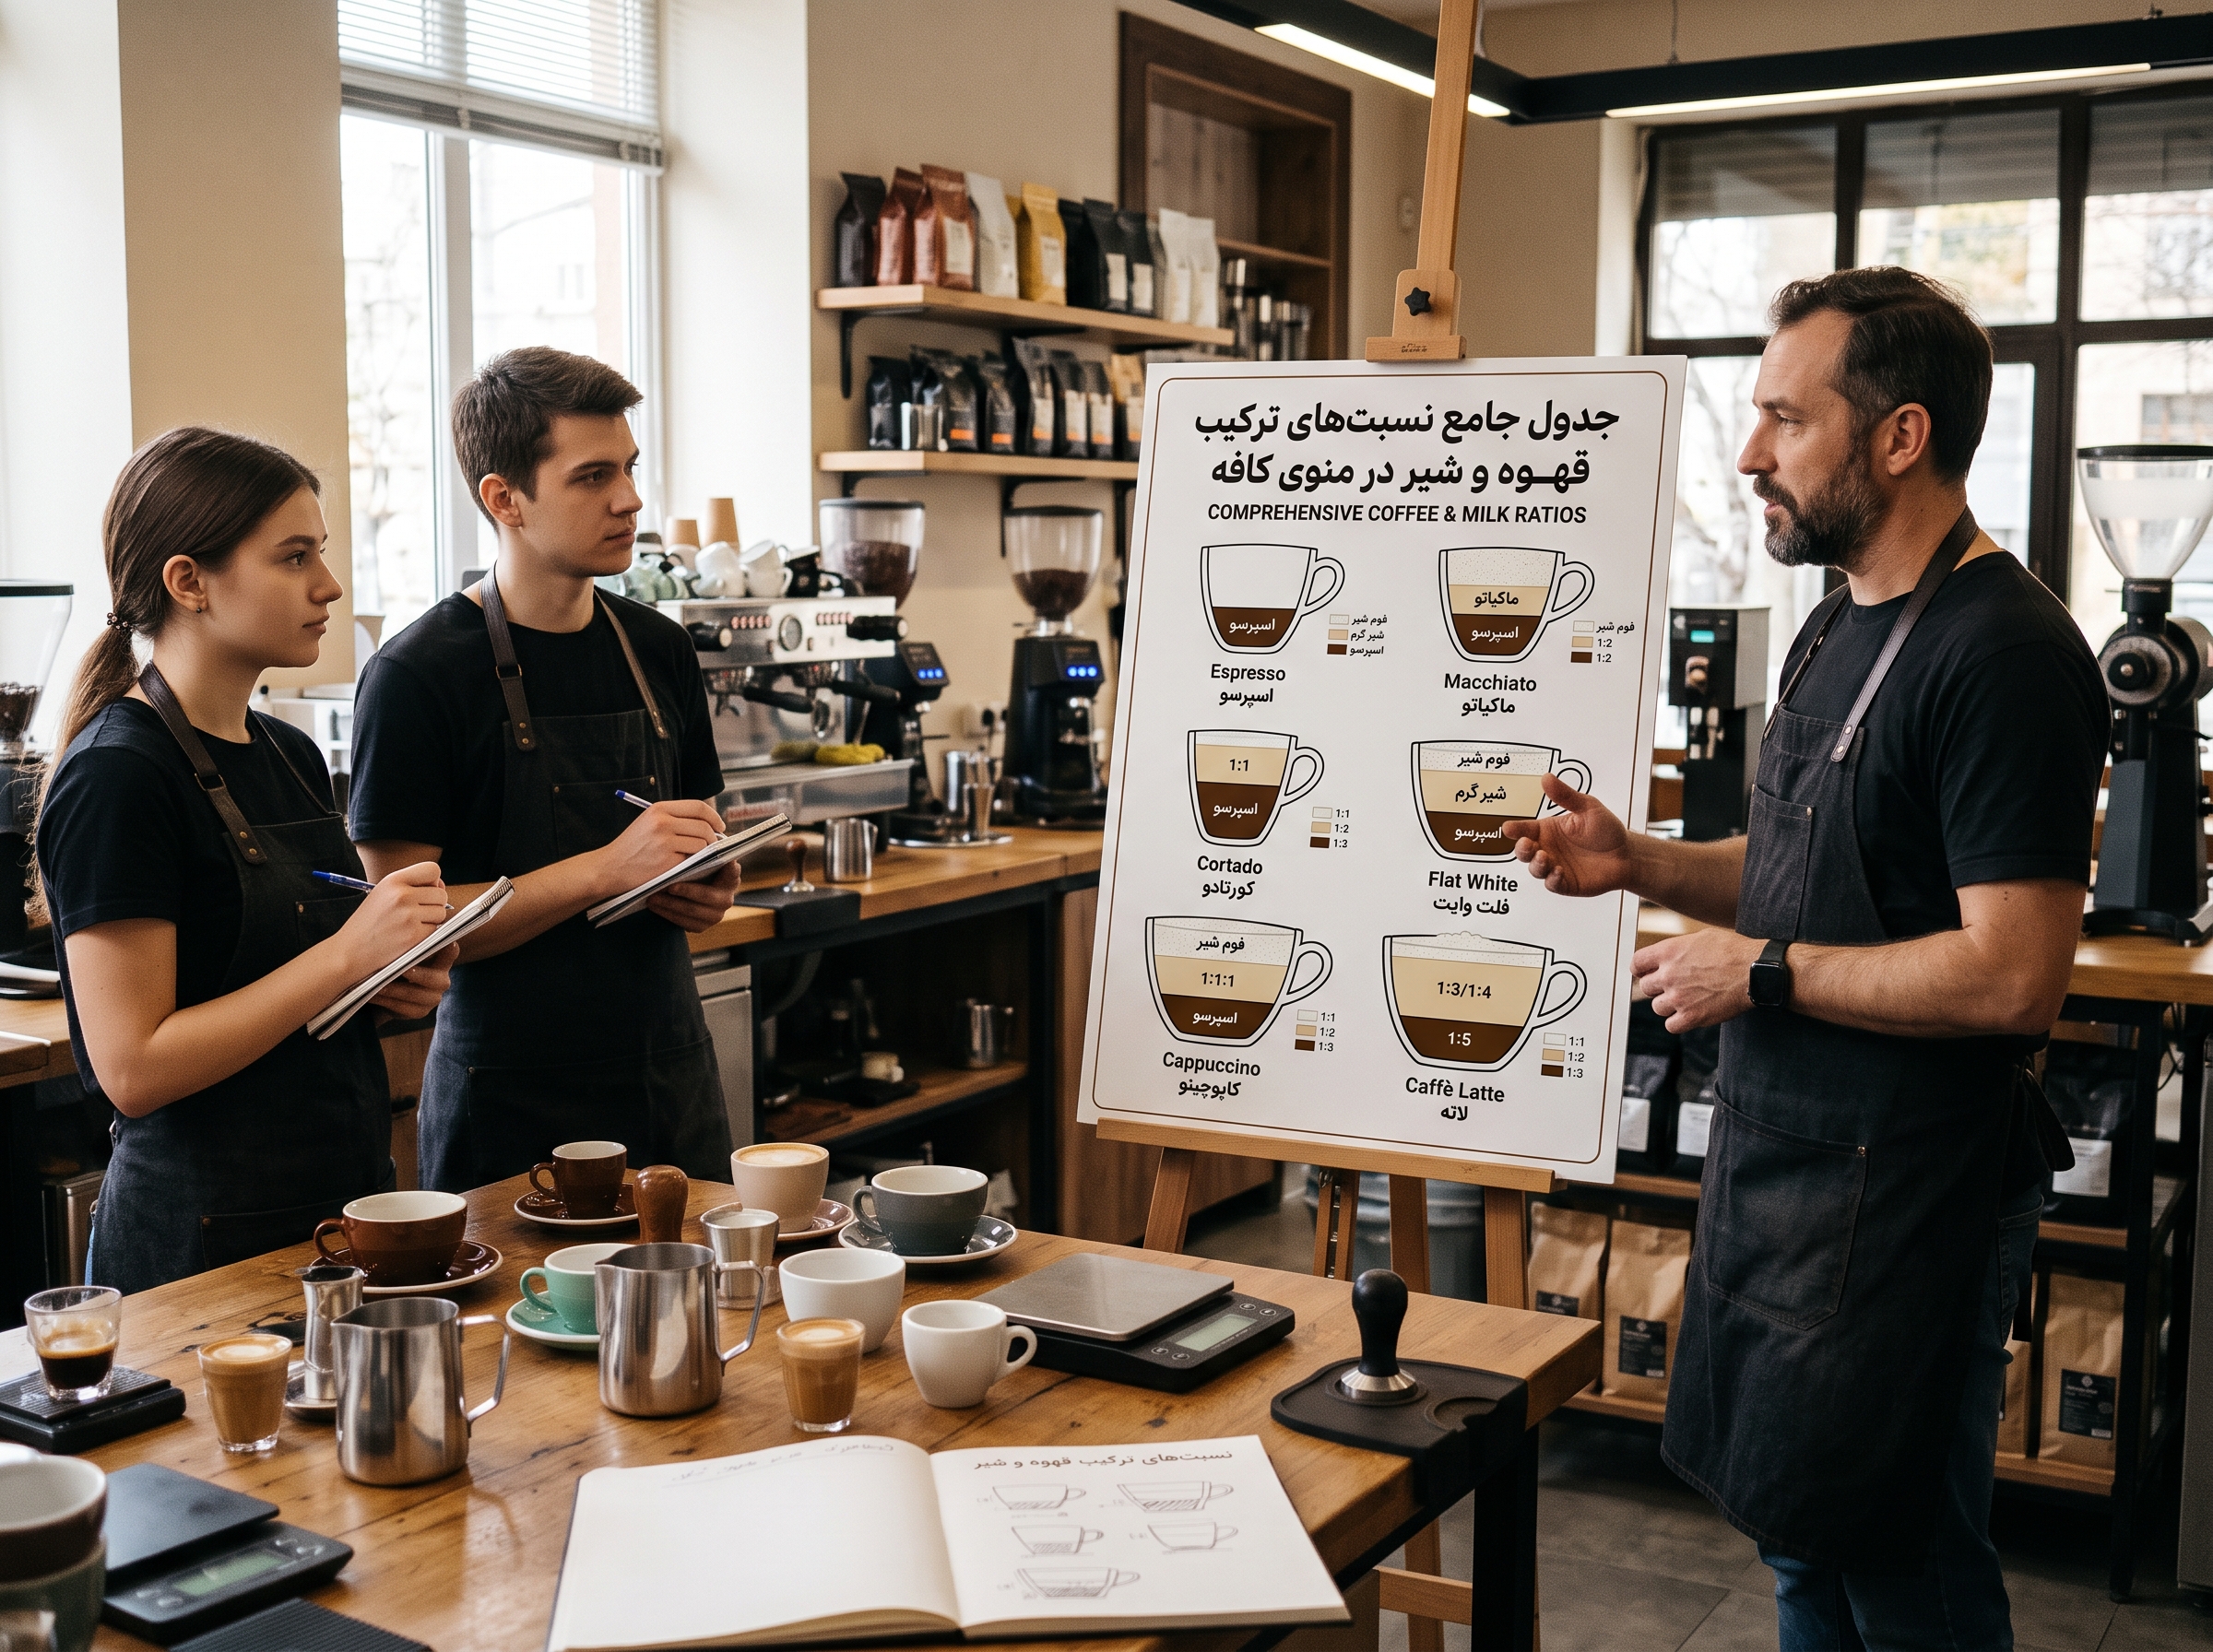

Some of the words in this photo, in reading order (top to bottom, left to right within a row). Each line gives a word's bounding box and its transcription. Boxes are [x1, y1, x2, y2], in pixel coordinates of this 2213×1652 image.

[1196, 403, 1280, 442] ترکیب
[1442, 400, 1520, 443] جامع
[1528, 400, 1619, 441] جدول
[1213, 451, 1274, 483] کافه
[1401, 455, 1462, 492] شیر
[1279, 460, 1354, 492] منوی
[1360, 462, 1393, 493] در
[1471, 465, 1489, 493] و
[1209, 504, 1363, 521] COMPREHENSIVE
[1368, 505, 1439, 521] COFFEE
[1444, 506, 1456, 522] &
[1462, 506, 1509, 522] MILK
[1515, 506, 1586, 523] RATIOS
[1474, 592, 1519, 608] ماکیاتو
[1229, 619, 1274, 634] اسپرسو
[1472, 626, 1518, 643] اسپرسو
[1597, 639, 1612, 647] 1:2
[1596, 654, 1611, 662] 1:2
[1211, 664, 1285, 683] Espresso
[1444, 674, 1536, 691] Macchiato
[1218, 689, 1273, 708] اسپرسو
[1461, 698, 1515, 716] ماکیاتو
[1229, 759, 1248, 771] 1:1
[1456, 751, 1483, 767] شیر
[1485, 753, 1509, 769] فوم
[1455, 783, 1479, 802] گرم
[1479, 785, 1507, 803] شیر
[1213, 803, 1257, 819] اسپرسو
[1335, 809, 1349, 818] 1:1
[1334, 824, 1348, 832] 1:2
[1454, 826, 1502, 844] اسپرسو
[1333, 839, 1347, 847] 1:3
[1197, 856, 1262, 874] Cortado
[1428, 871, 1462, 888] Flat
[1466, 874, 1518, 891] White
[1201, 880, 1255, 900] کورتادو
[1433, 897, 1472, 916] وایت
[1475, 899, 1509, 914] فلت
[1222, 938, 1244, 953] فوم
[1201, 973, 1234, 986] 1:1:1
[1437, 982, 1491, 998] 1:3/1:4
[1192, 1012, 1237, 1027] اسپرسو
[1320, 1012, 1334, 1021] 1:1
[1320, 1028, 1334, 1037] 1:2
[1448, 1032, 1471, 1045] 1:5
[1319, 1043, 1333, 1051] 1:3
[1568, 1037, 1583, 1046] 1:1
[1163, 1052, 1260, 1077] Cappuccino
[1568, 1052, 1584, 1062] 1:2
[1567, 1068, 1582, 1078] 1:3
[1178, 1079, 1241, 1101] کاپوچینو
[1405, 1078, 1453, 1096] Caffè
[1458, 1082, 1504, 1102] Latte
[1440, 1106, 1467, 1121] لاته
